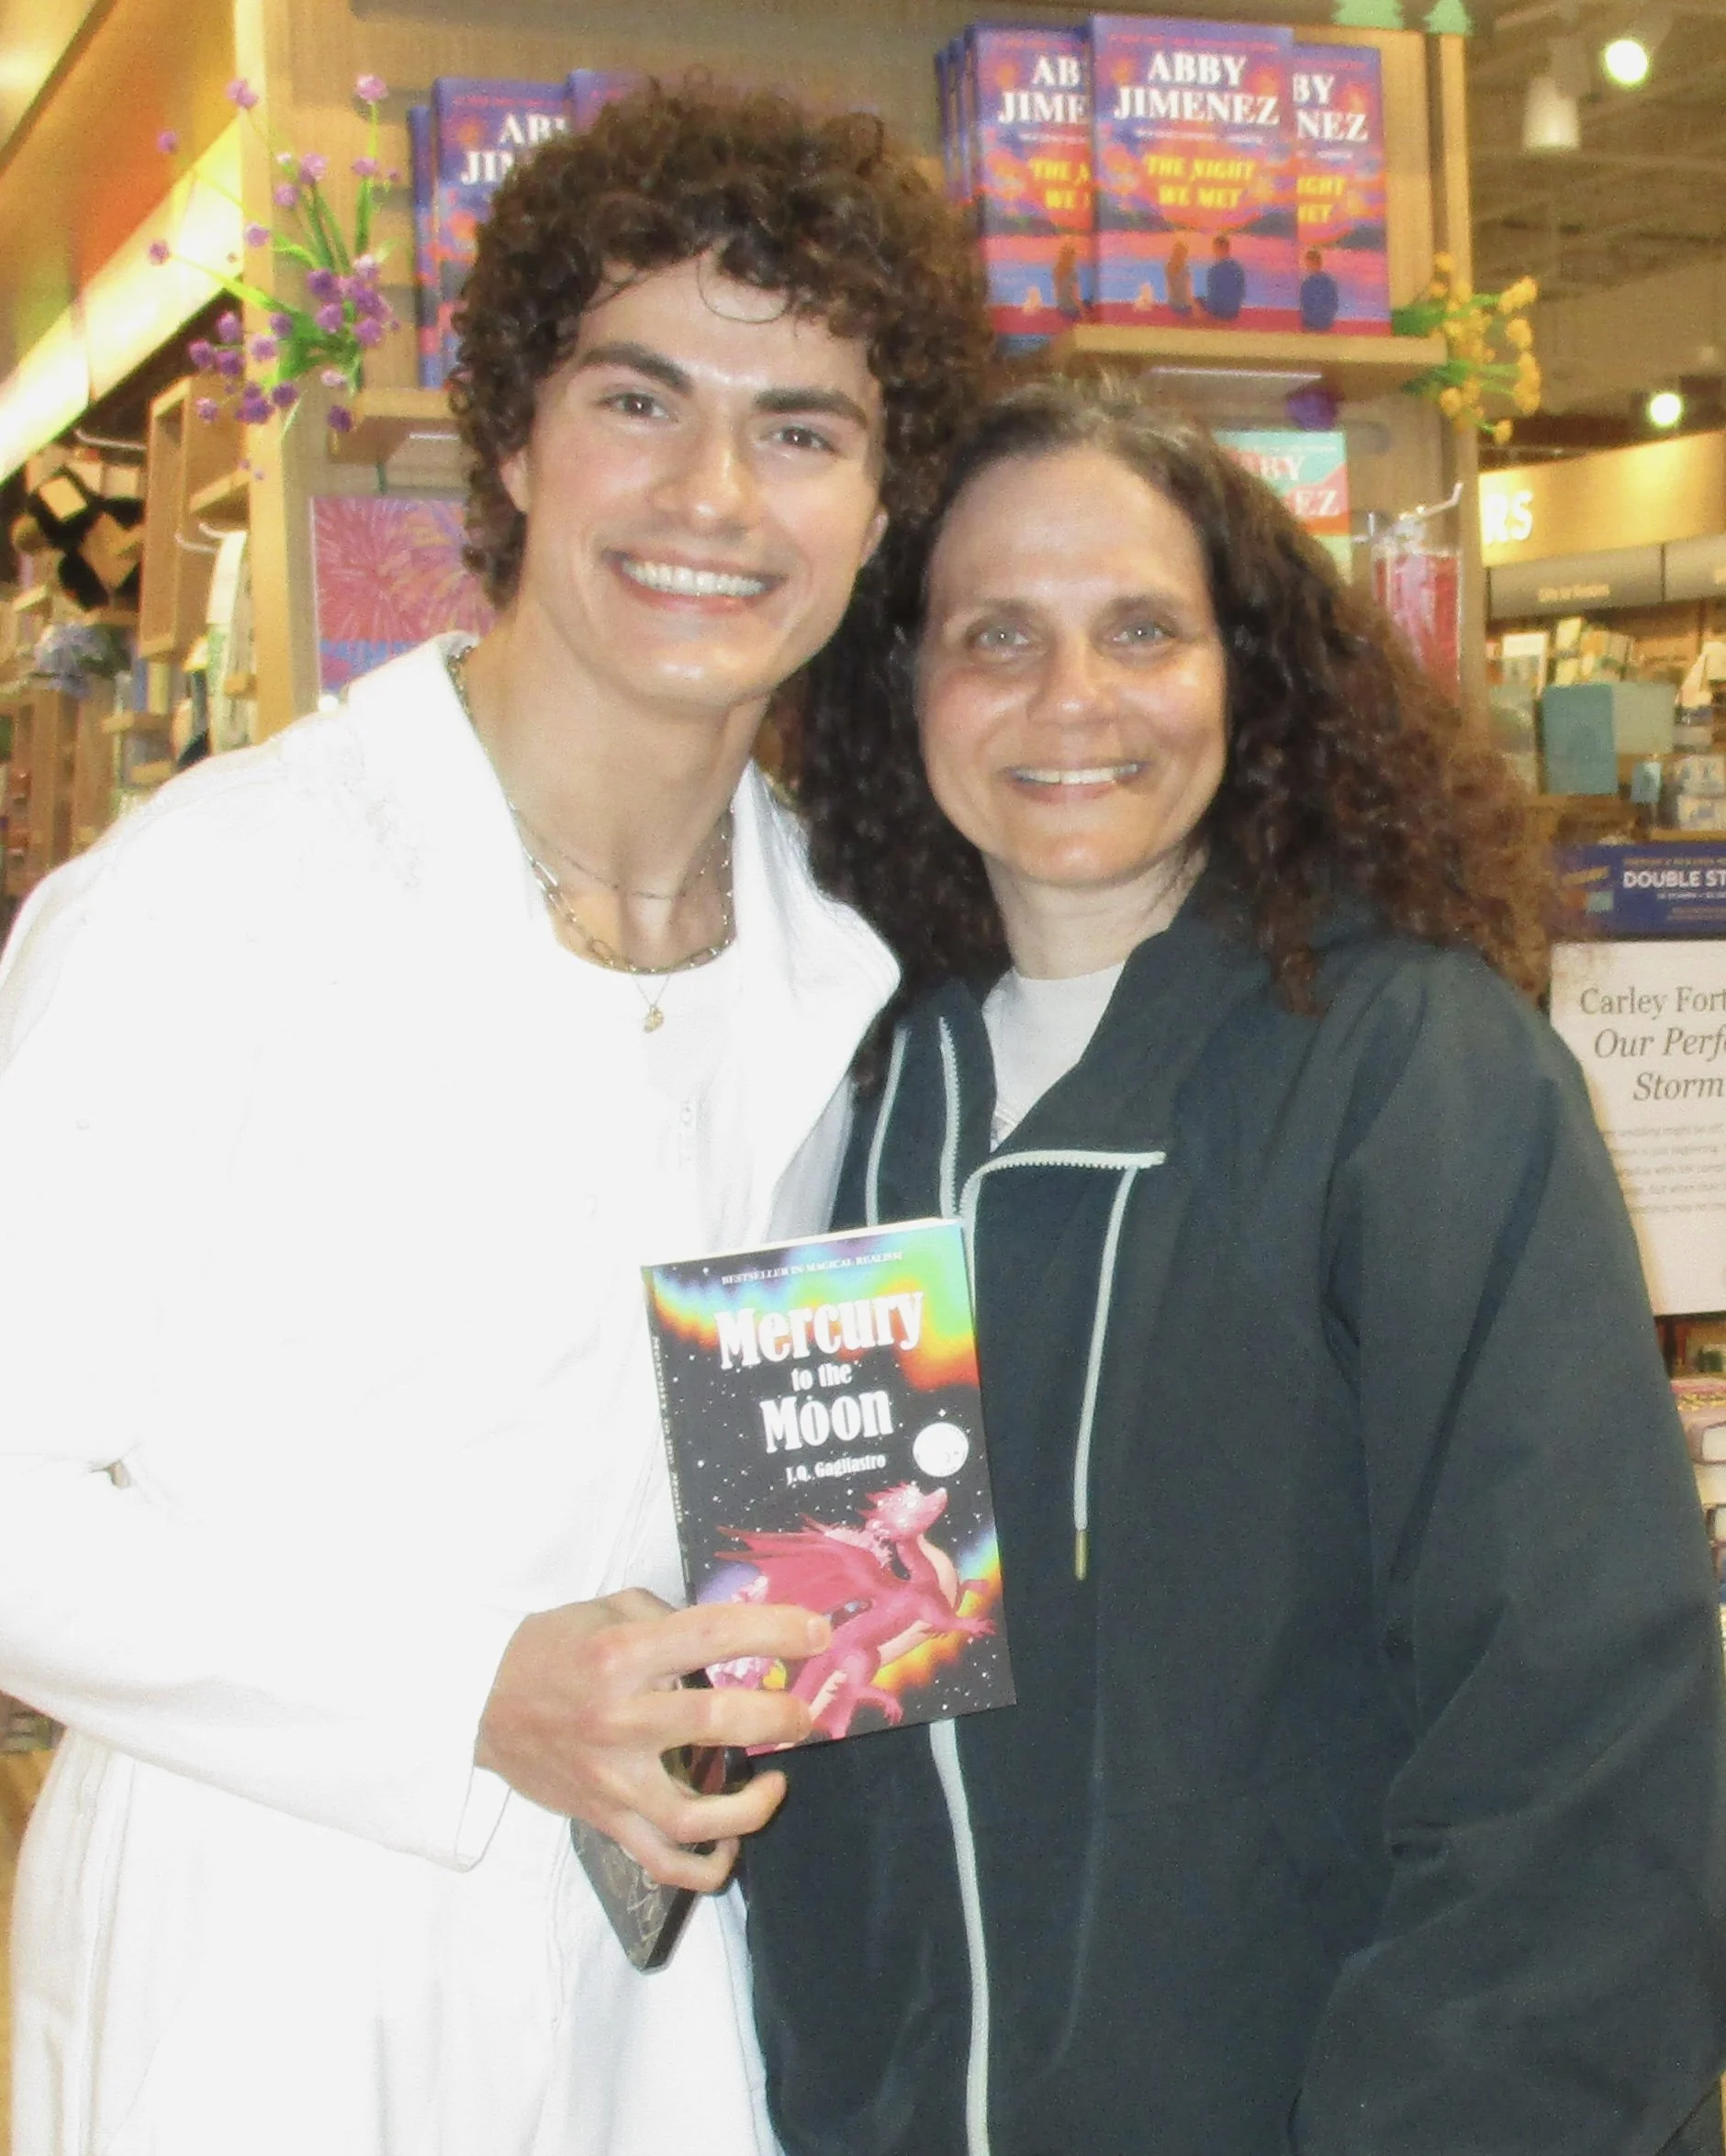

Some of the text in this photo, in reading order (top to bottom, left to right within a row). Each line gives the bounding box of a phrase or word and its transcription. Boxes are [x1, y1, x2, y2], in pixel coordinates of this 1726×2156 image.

[1033, 54, 1081, 86] AB
[1149, 50, 1248, 86] ABBY
[1293, 73, 1335, 104] BY
[1114, 85, 1282, 126] JIMENEZ
[1296, 108, 1369, 141] NEZ
[1145, 154, 1256, 182] THE NIGHT
[1158, 184, 1244, 210] WE MET
[1622, 869, 1702, 889] DOUBLE
[1579, 985, 1668, 1021] Carley
[1594, 1023, 1726, 1063] Our Perf
[1632, 1071, 1724, 1101] Storm
[721, 1250, 904, 1286] BESTSELLER IN MAGICAL REALISM
[713, 1290, 924, 1370] Mercury
[790, 1362, 853, 1391] to the
[758, 1390, 894, 1454] Moon
[785, 1454, 887, 1486] J.Q. Gagliastro
